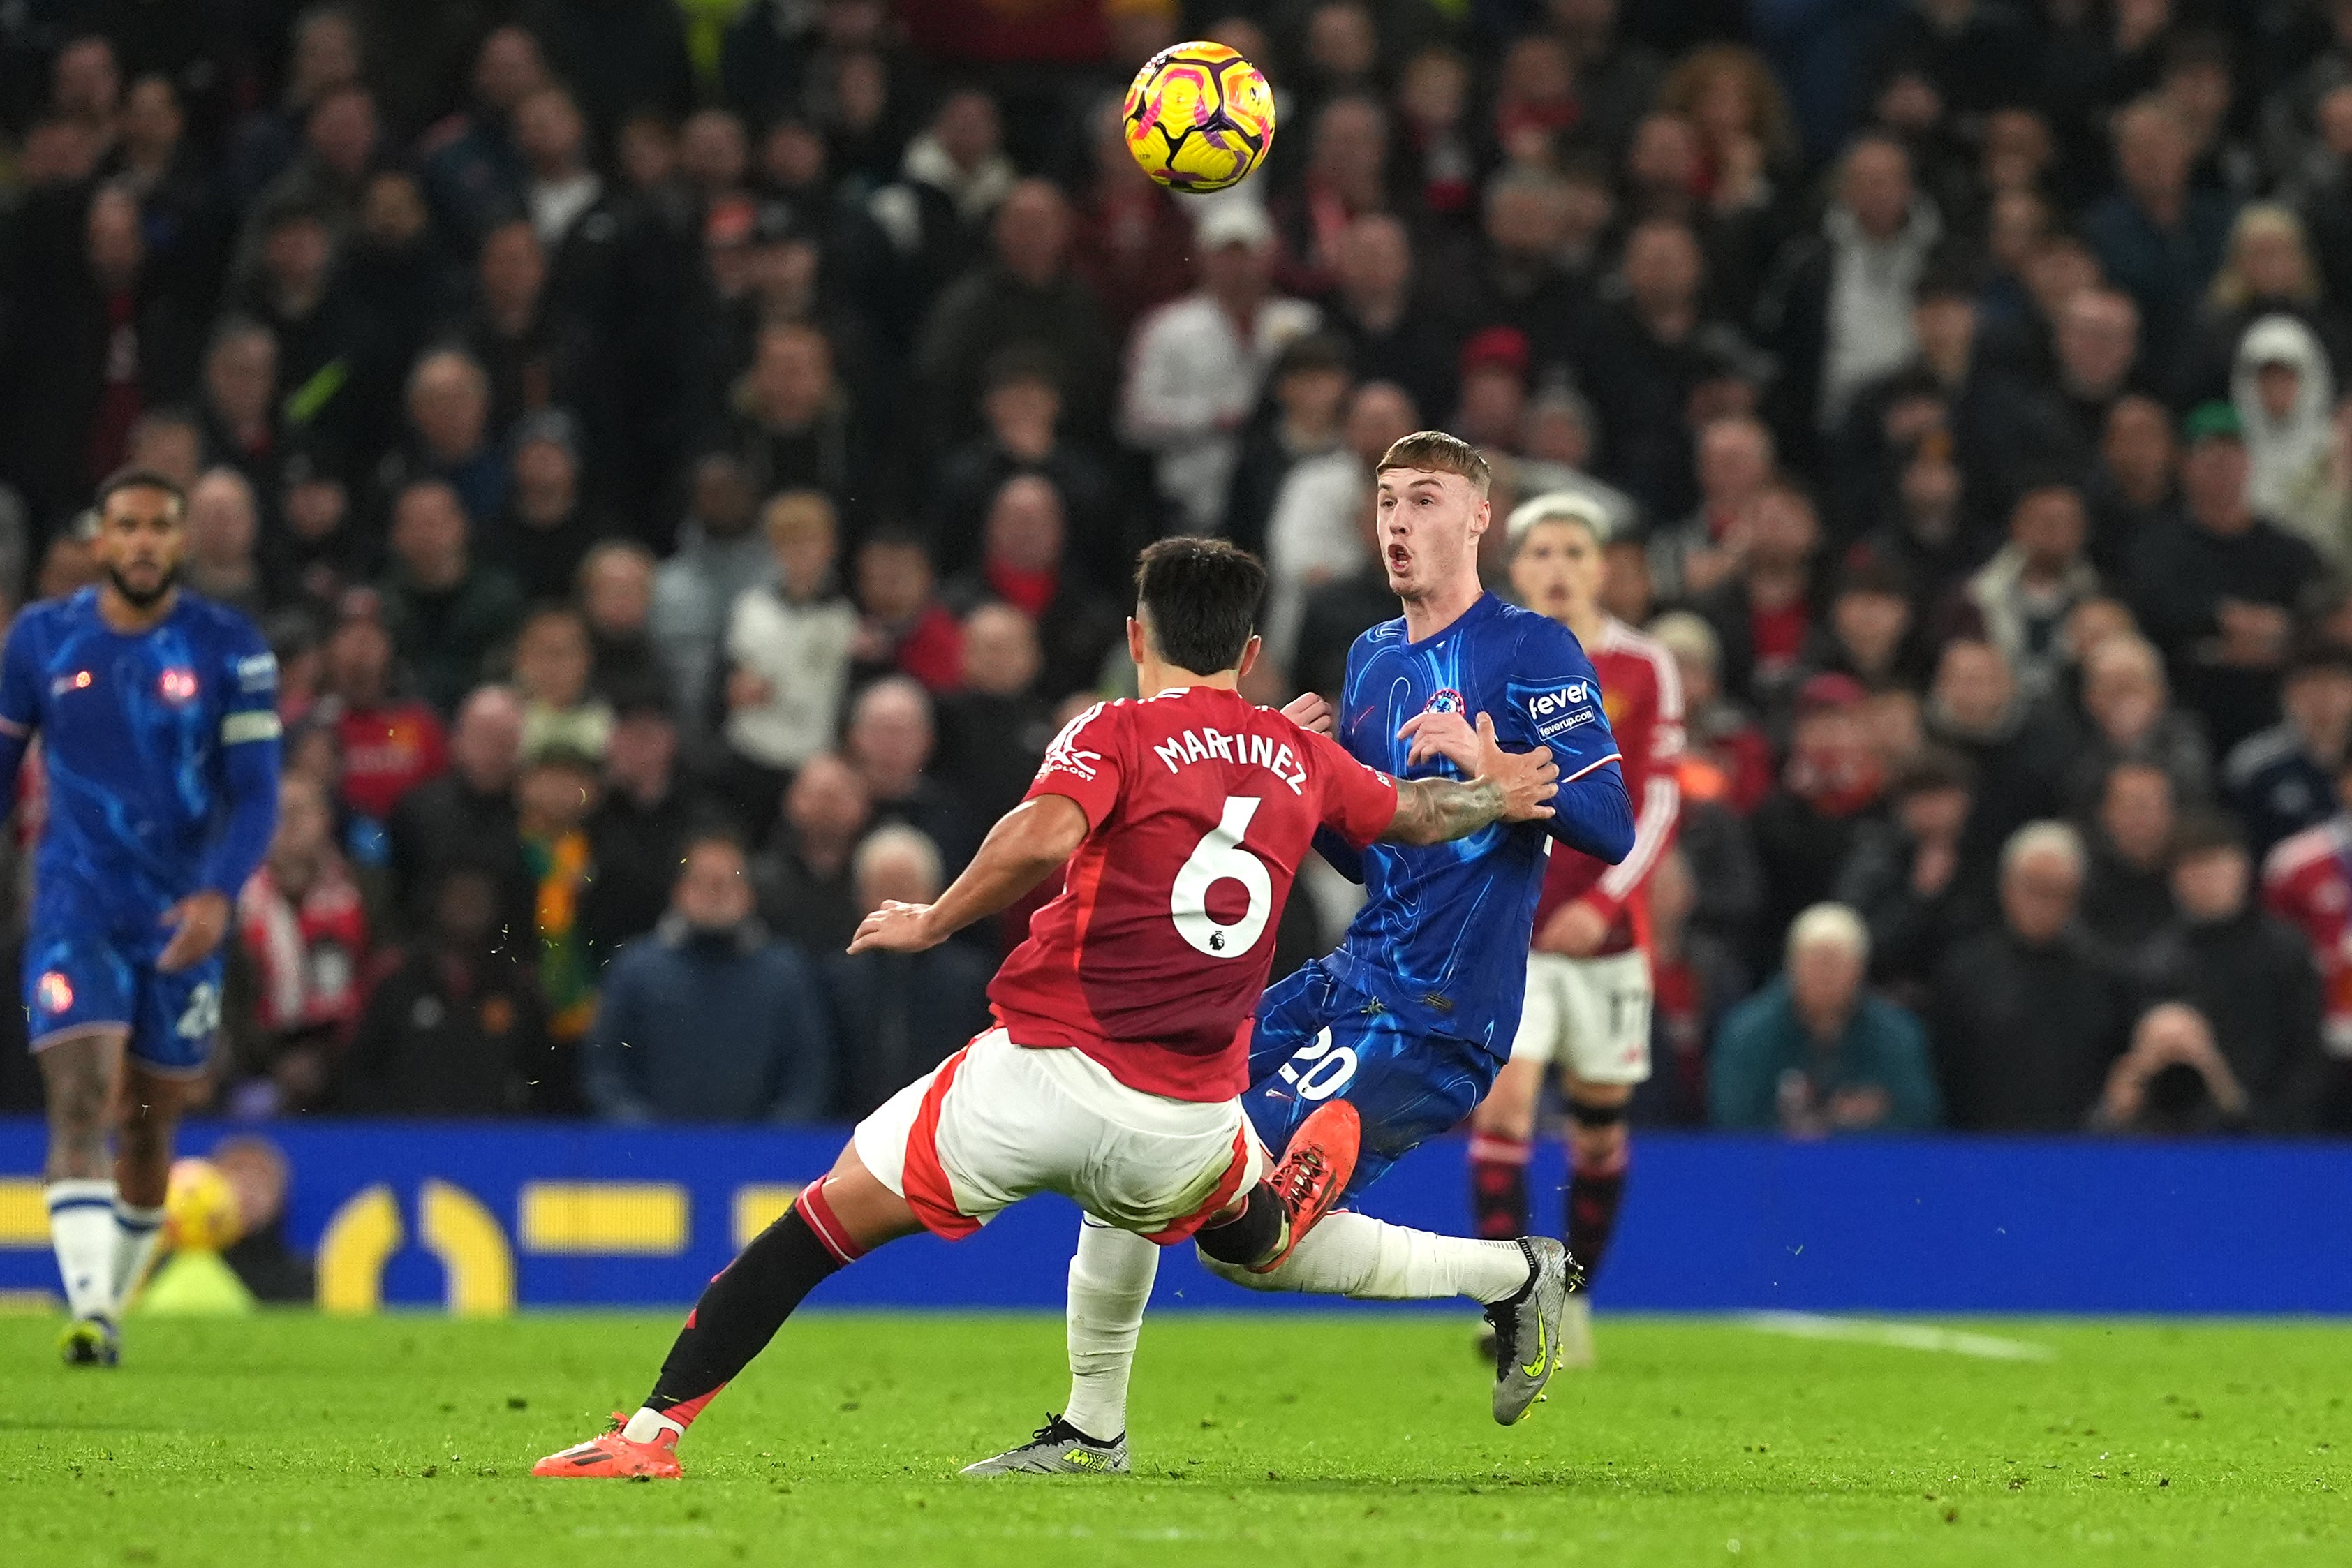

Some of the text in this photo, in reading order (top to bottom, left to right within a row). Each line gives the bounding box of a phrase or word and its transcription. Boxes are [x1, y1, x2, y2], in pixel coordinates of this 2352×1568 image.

[1529, 681, 1588, 720] fever
[1153, 727, 1307, 796] MARTINEZ
[1171, 795, 1271, 959] 6
[1278, 1026, 1358, 1101] 20
